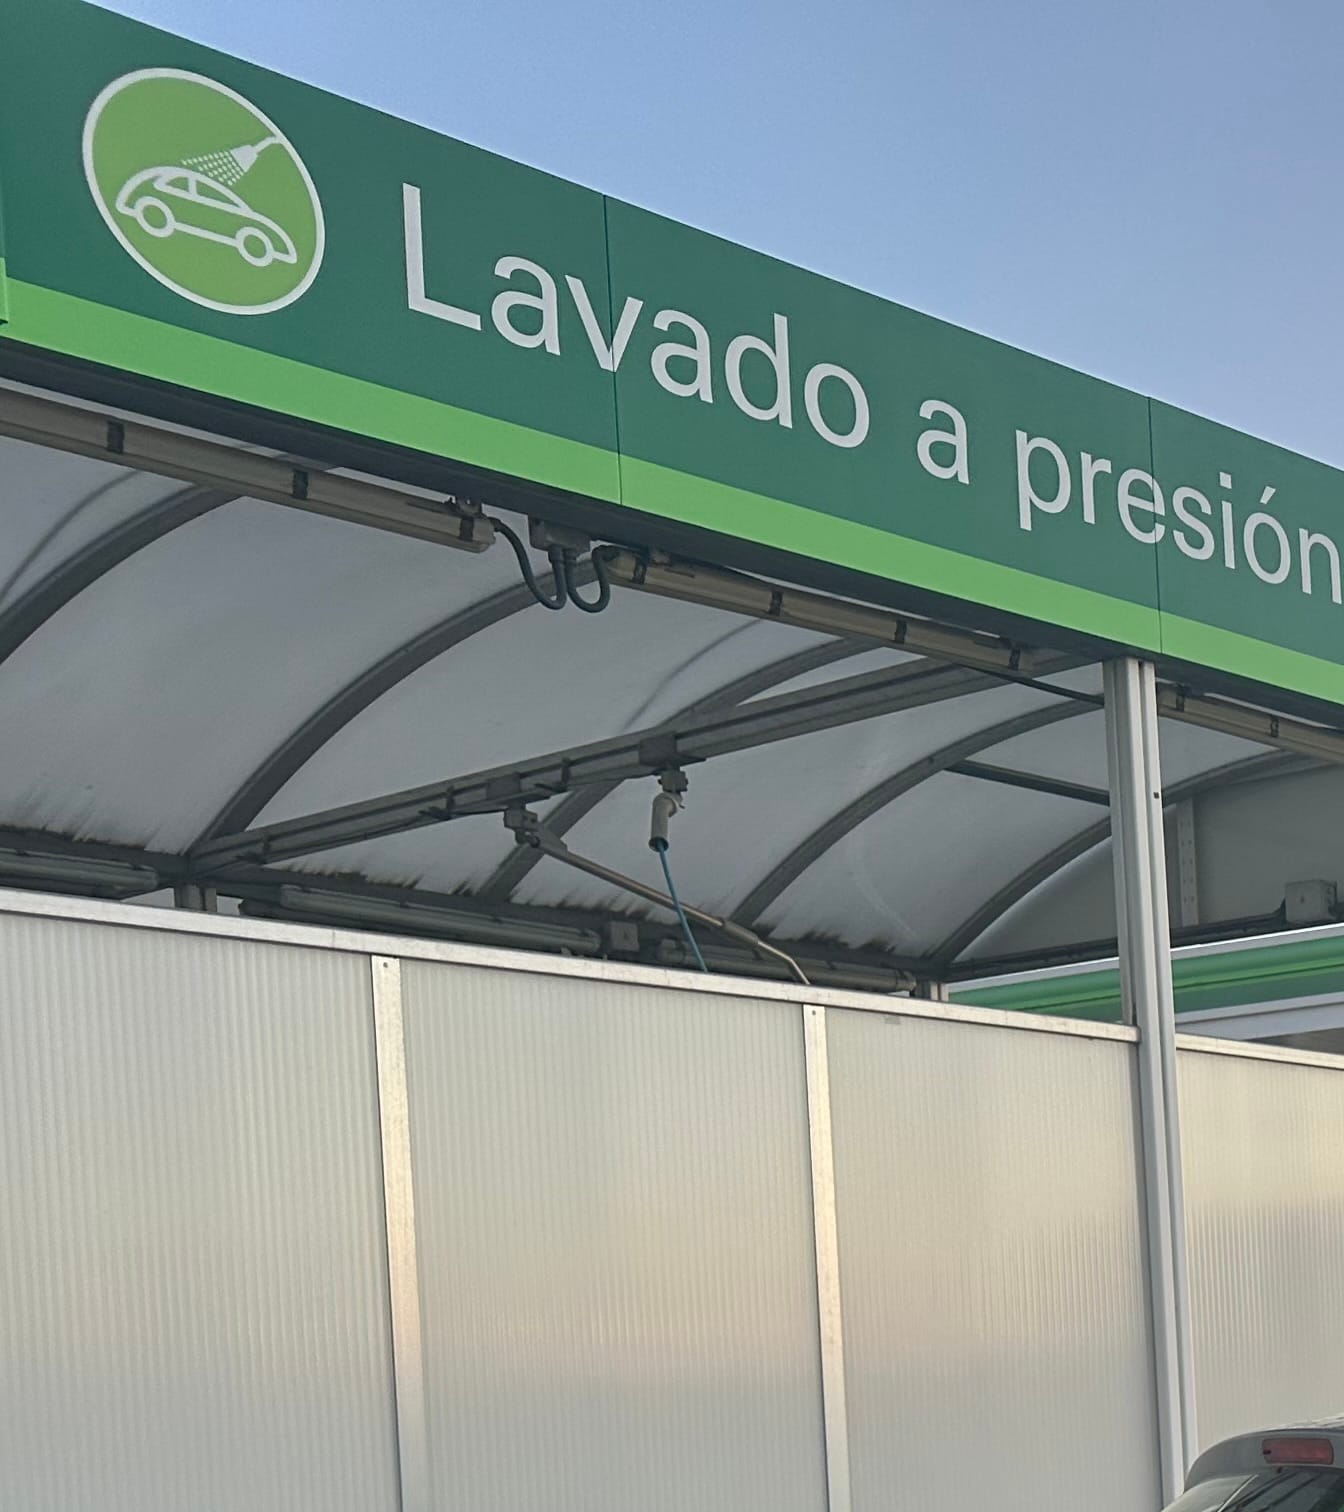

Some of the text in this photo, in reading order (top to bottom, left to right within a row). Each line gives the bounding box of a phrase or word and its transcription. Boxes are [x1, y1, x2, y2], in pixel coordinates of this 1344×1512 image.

[402, 182, 1343, 605] Lavado a presión
